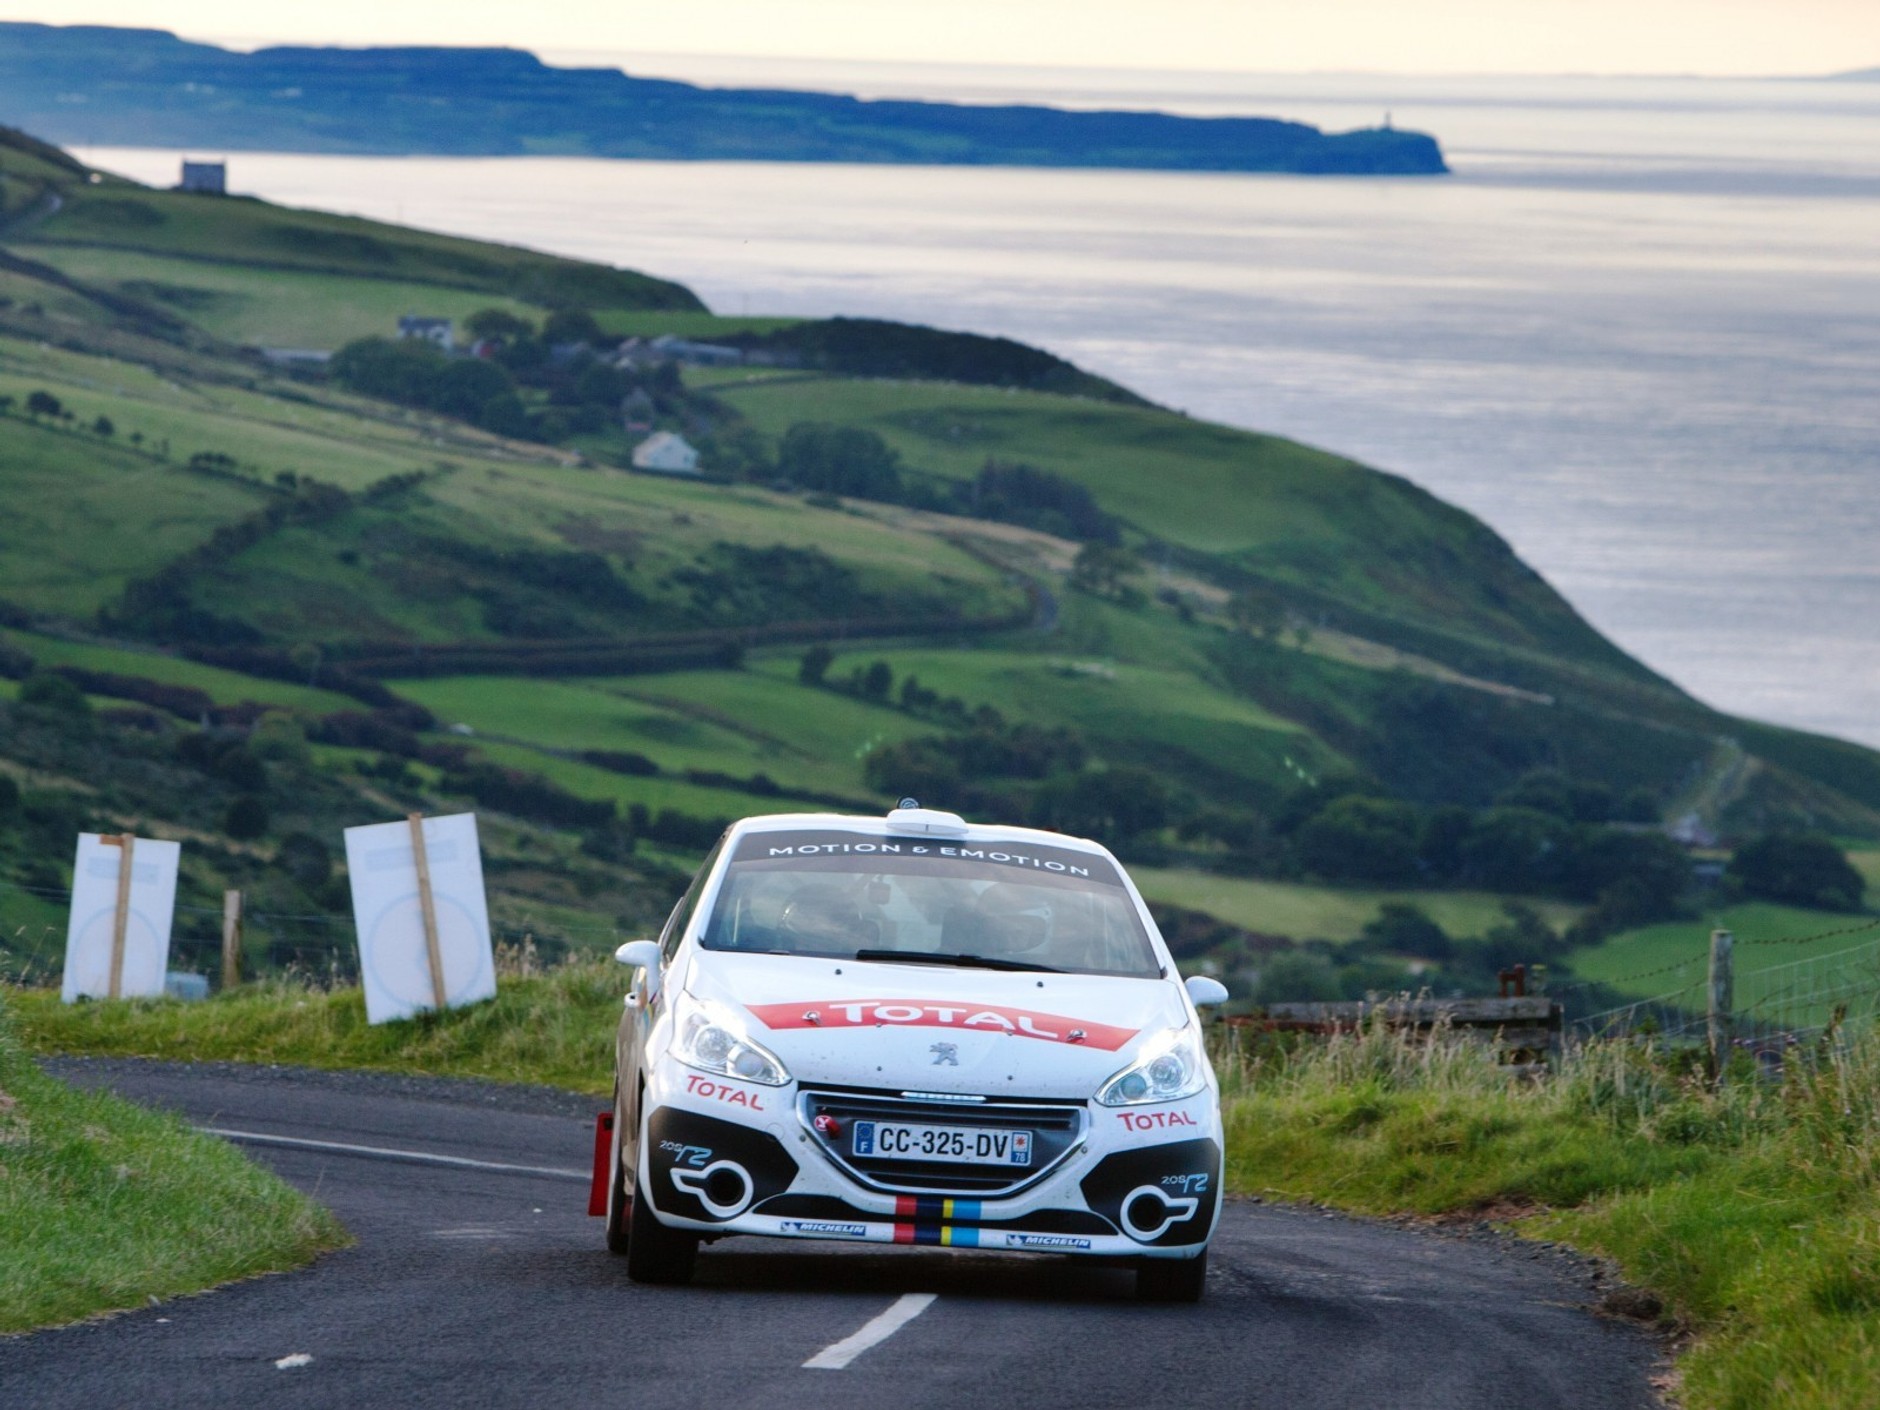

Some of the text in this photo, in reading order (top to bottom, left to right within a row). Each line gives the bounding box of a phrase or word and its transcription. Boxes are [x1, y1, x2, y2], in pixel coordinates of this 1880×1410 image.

[769, 843, 1089, 877] MOTION & EMOTION
[829, 1002, 1059, 1038] TOTAL
[687, 1075, 765, 1111] TOTAL
[1116, 1111, 1198, 1132] TOTAL
[860, 1141, 869, 1152] F
[879, 1127, 1009, 1158] CC-325-DV
[800, 1223, 866, 1234] MICHELIN
[1025, 1235, 1091, 1247] MICHELIN
